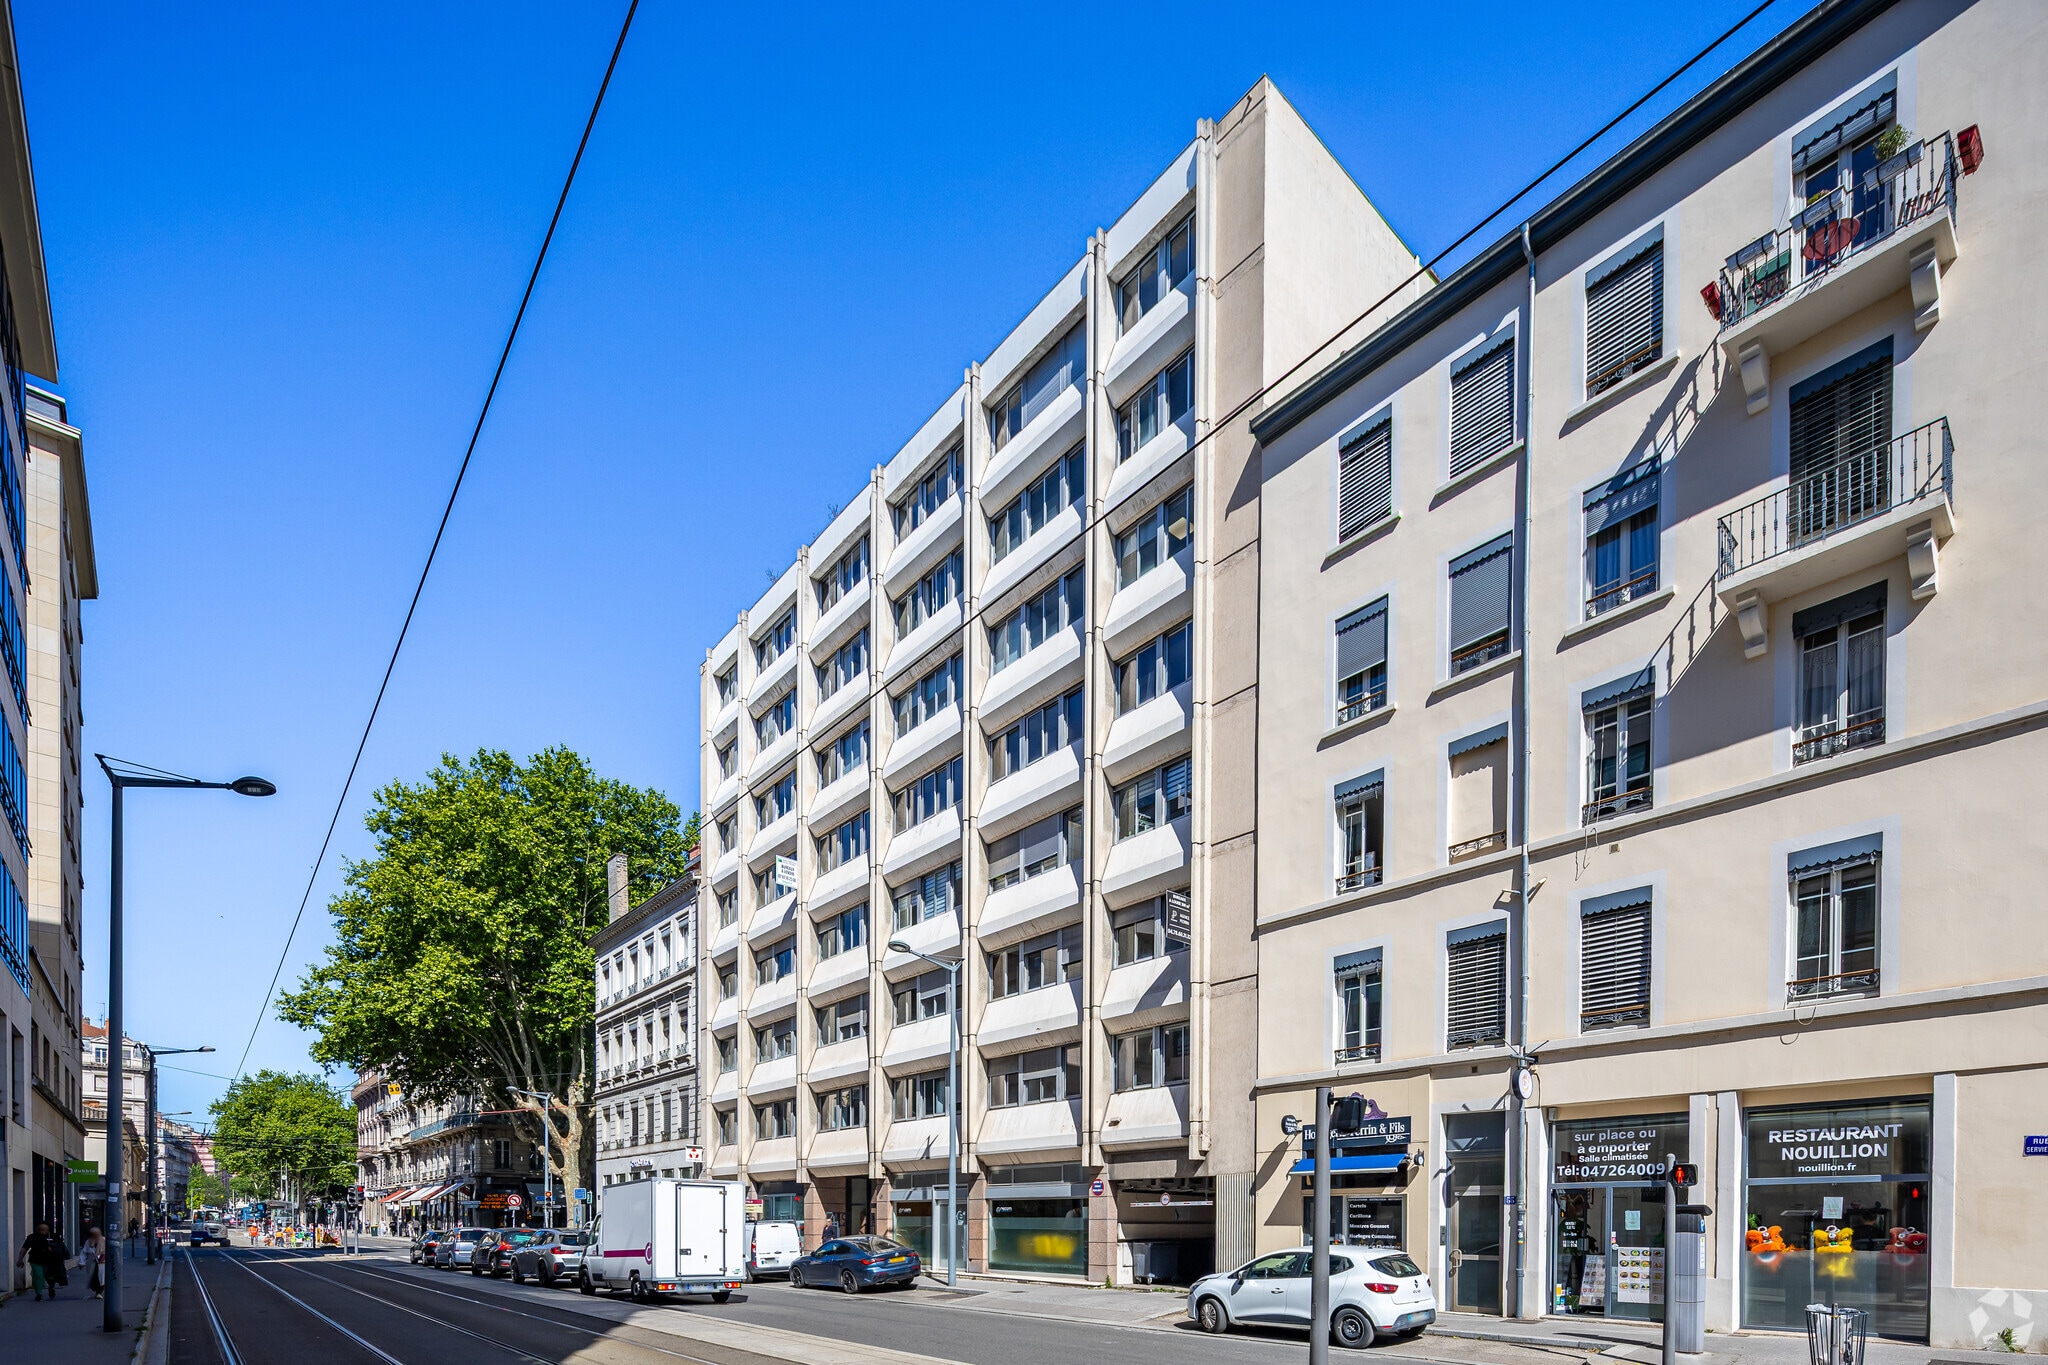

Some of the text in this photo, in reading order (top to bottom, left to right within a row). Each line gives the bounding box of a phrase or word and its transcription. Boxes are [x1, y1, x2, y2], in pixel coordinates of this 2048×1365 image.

[1388, 1121, 1405, 1134] Fils
[1768, 1124, 1903, 1143] RESTAURANT
[1574, 1129, 1656, 1142] sur place ou
[1577, 1141, 1651, 1155] à emporter
[1781, 1143, 1888, 1160] NOUILLION
[1578, 1152, 1649, 1163] Salle climatisée
[1557, 1163, 1666, 1177] Tél: 047264009
[1798, 1162, 1857, 1172] nouillion.fr
